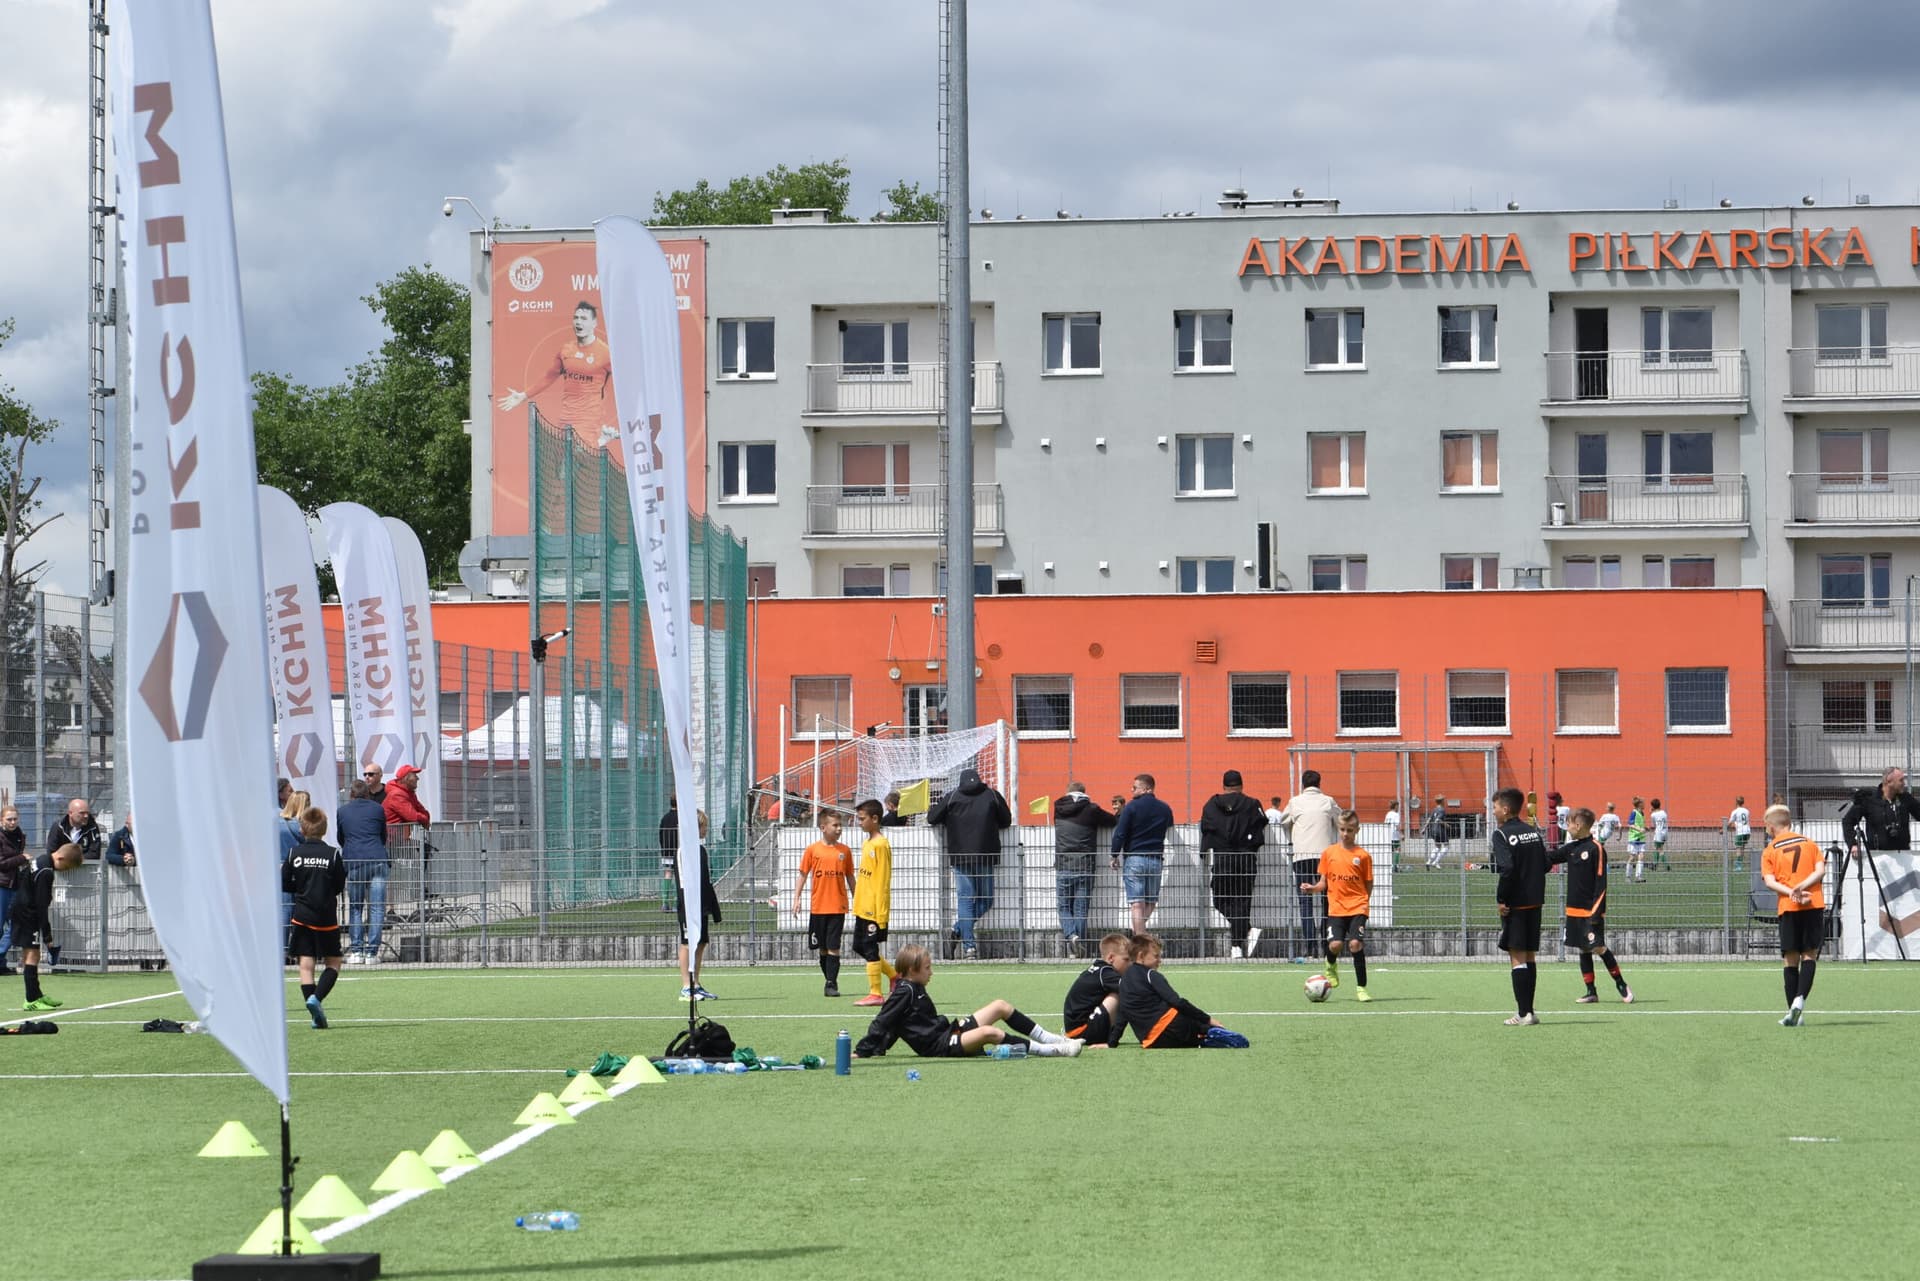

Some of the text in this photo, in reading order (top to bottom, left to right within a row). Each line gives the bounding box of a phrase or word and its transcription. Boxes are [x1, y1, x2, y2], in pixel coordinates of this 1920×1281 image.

[1238, 233, 1531, 276] AKADEMIA
[1568, 226, 1874, 272] PIŁKARSKA
[571, 274, 585, 290] W
[522, 301, 553, 309] KGHM
[304, 857, 329, 867] KGHM
[1783, 844, 1801, 873] 7
[811, 931, 818, 945] 6
